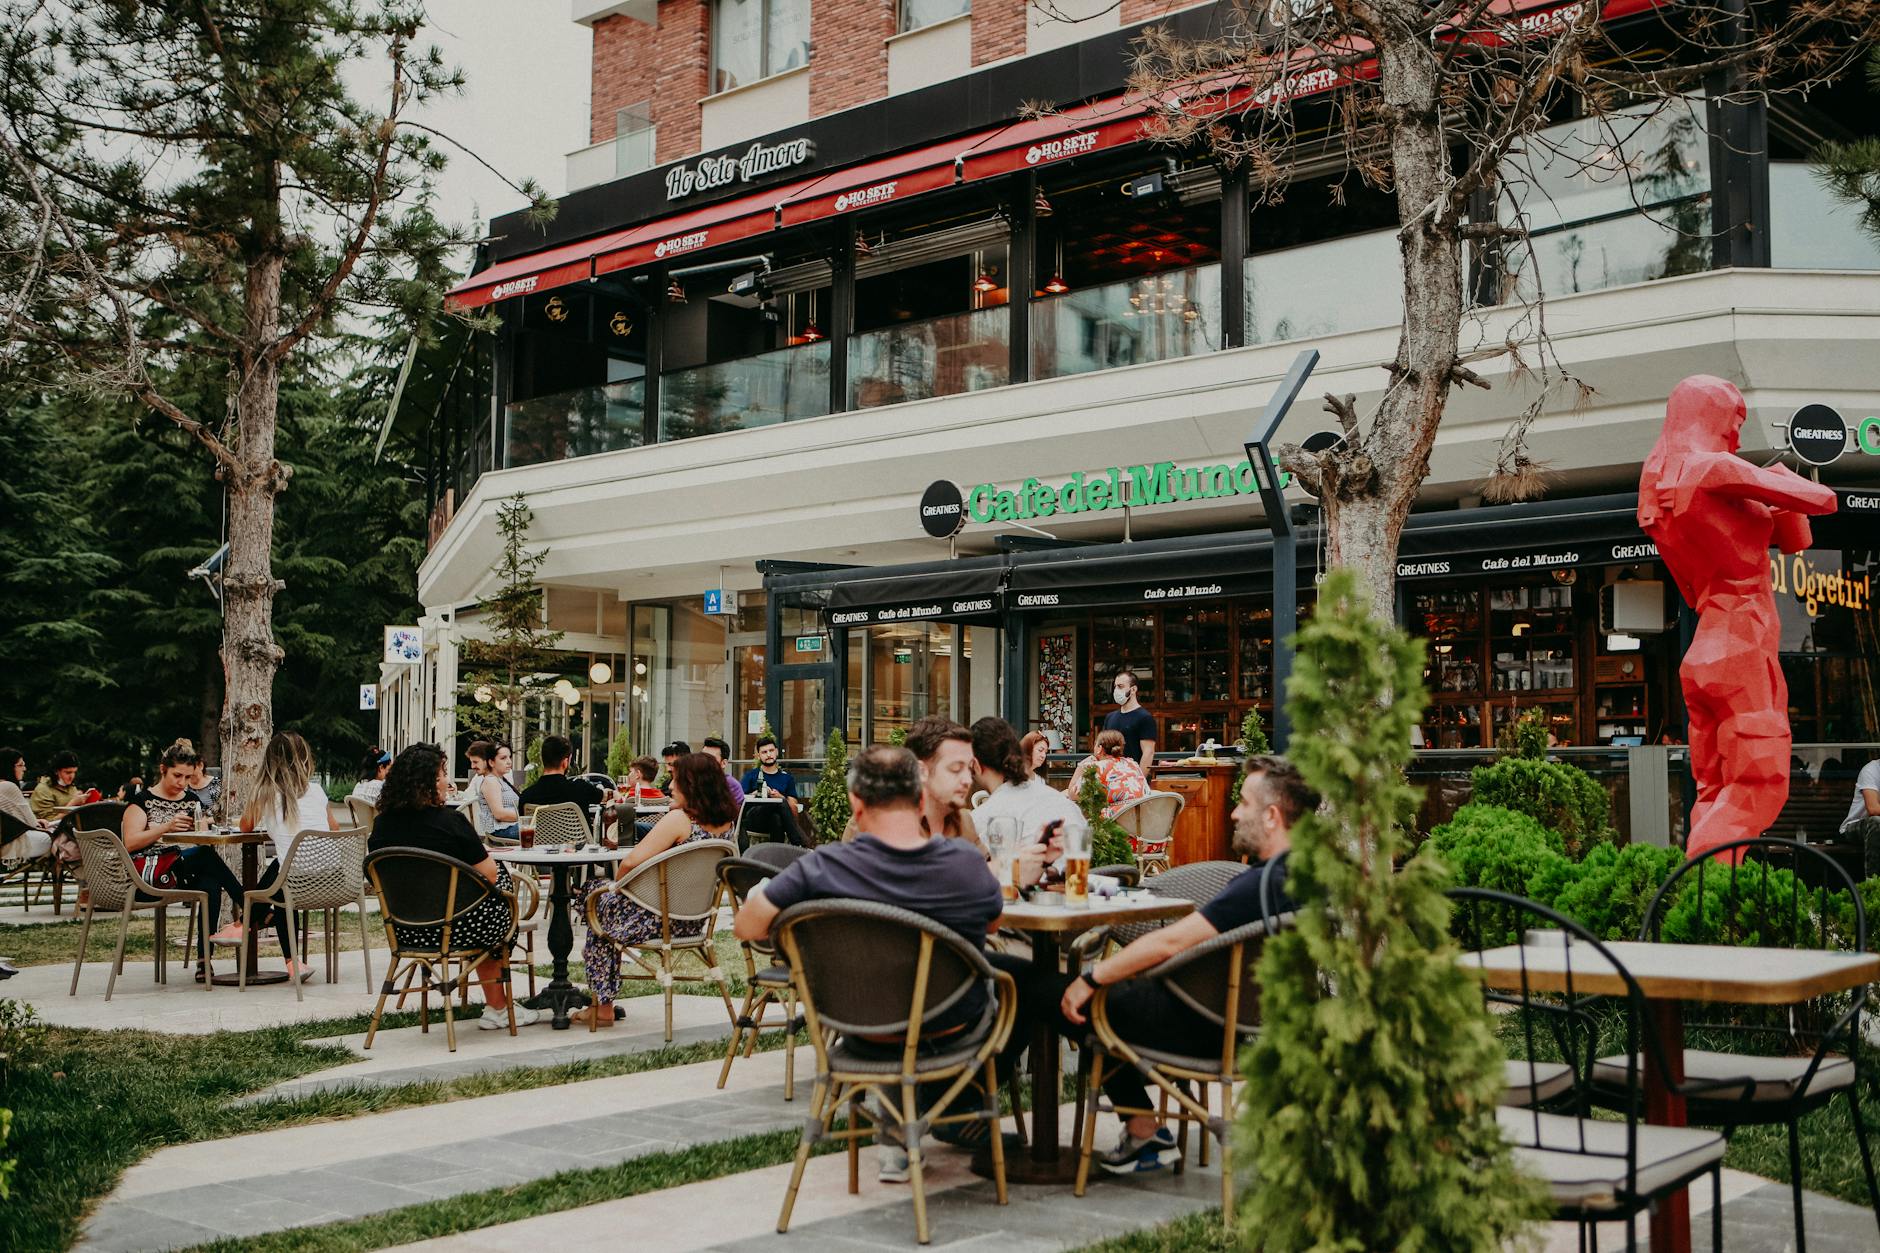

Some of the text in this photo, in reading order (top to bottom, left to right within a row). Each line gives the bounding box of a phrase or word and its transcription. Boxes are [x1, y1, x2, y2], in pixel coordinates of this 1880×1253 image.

[1041, 132, 1097, 157] HO SETE
[665, 138, 808, 200] Ho Sete Amore
[848, 182, 896, 204] HO SETE
[666, 231, 707, 251] HO SETE
[503, 281, 515, 293] HO
[515, 276, 537, 290] SETE
[1794, 427, 1843, 440] GREATNESS
[922, 503, 960, 517] GREATNESS
[968, 477, 1057, 523] Cafe
[1059, 466, 1125, 514] del
[1397, 562, 1450, 576] GREATNESS
[1482, 558, 1509, 570] Cafe
[1511, 555, 1530, 568] del
[1533, 552, 1579, 565] Mundo
[1017, 584, 1222, 606] GREATNESS Cafe del Mundo
[1793, 550, 1870, 617] Öğretir!
[709, 592, 717, 604] A
[832, 599, 992, 624] GREATNESS Cafe del Mundo GREATNESS
